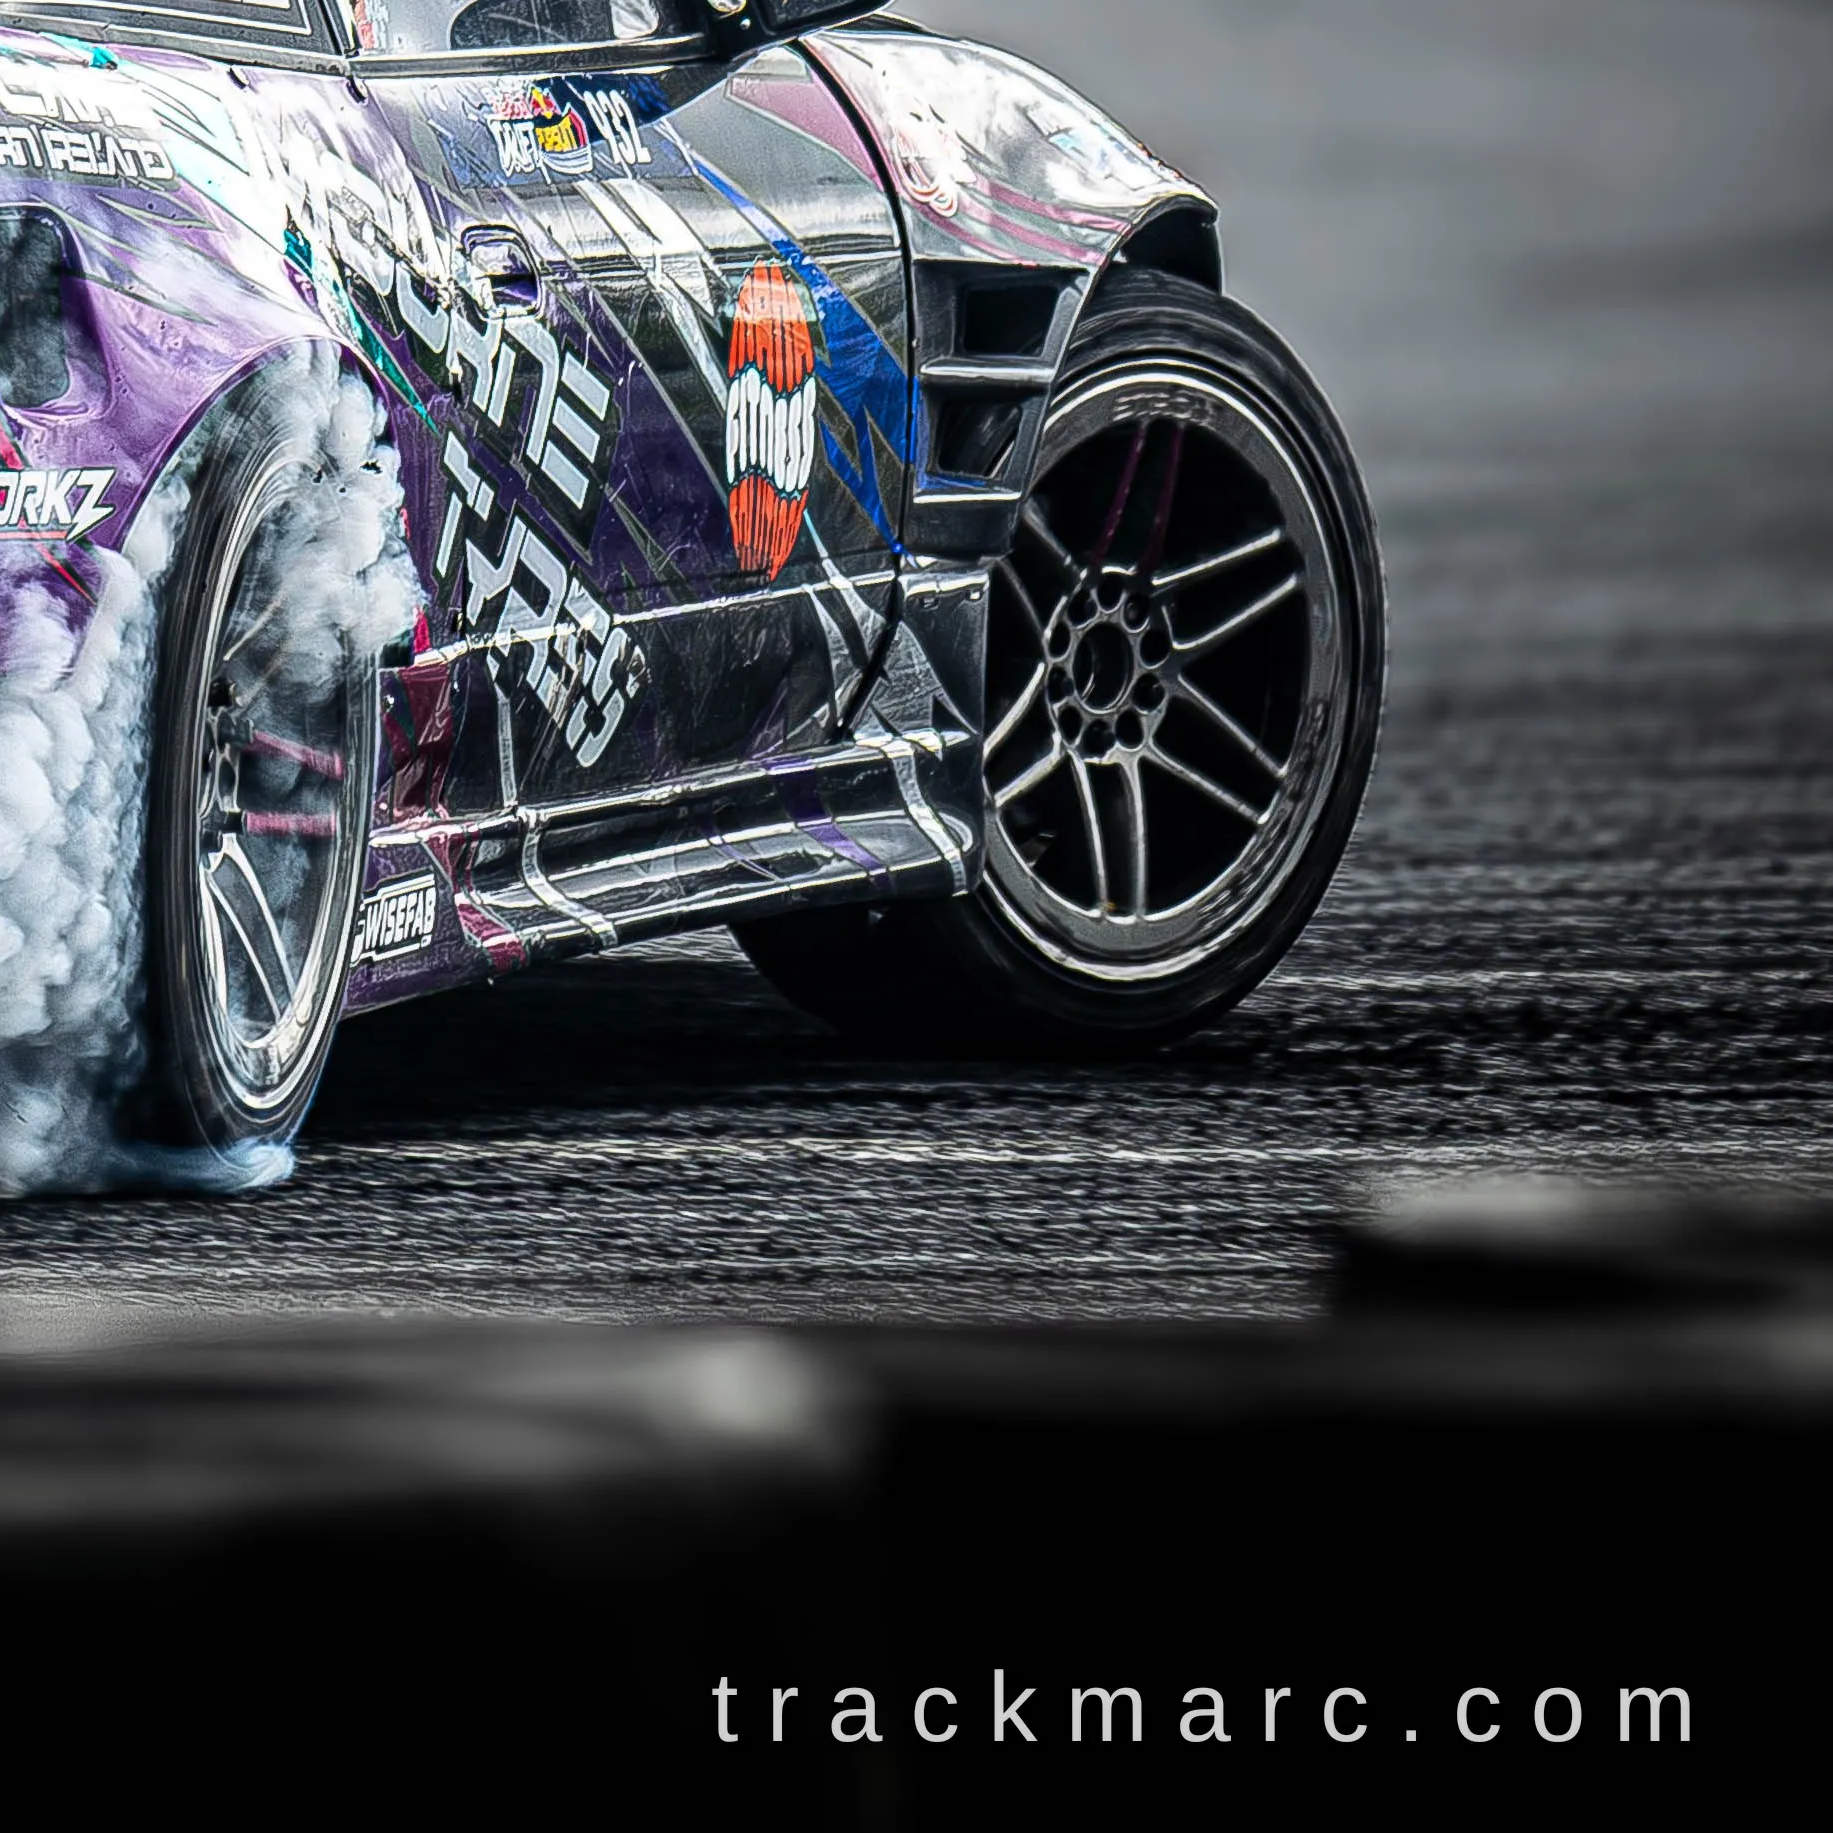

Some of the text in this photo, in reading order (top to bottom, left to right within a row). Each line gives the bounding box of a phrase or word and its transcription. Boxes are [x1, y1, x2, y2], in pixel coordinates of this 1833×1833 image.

[583, 89, 652, 166] 932
[726, 366, 817, 493] FITNESS
[436, 431, 645, 768] TYRES
[364, 886, 436, 950] WISEFAB
